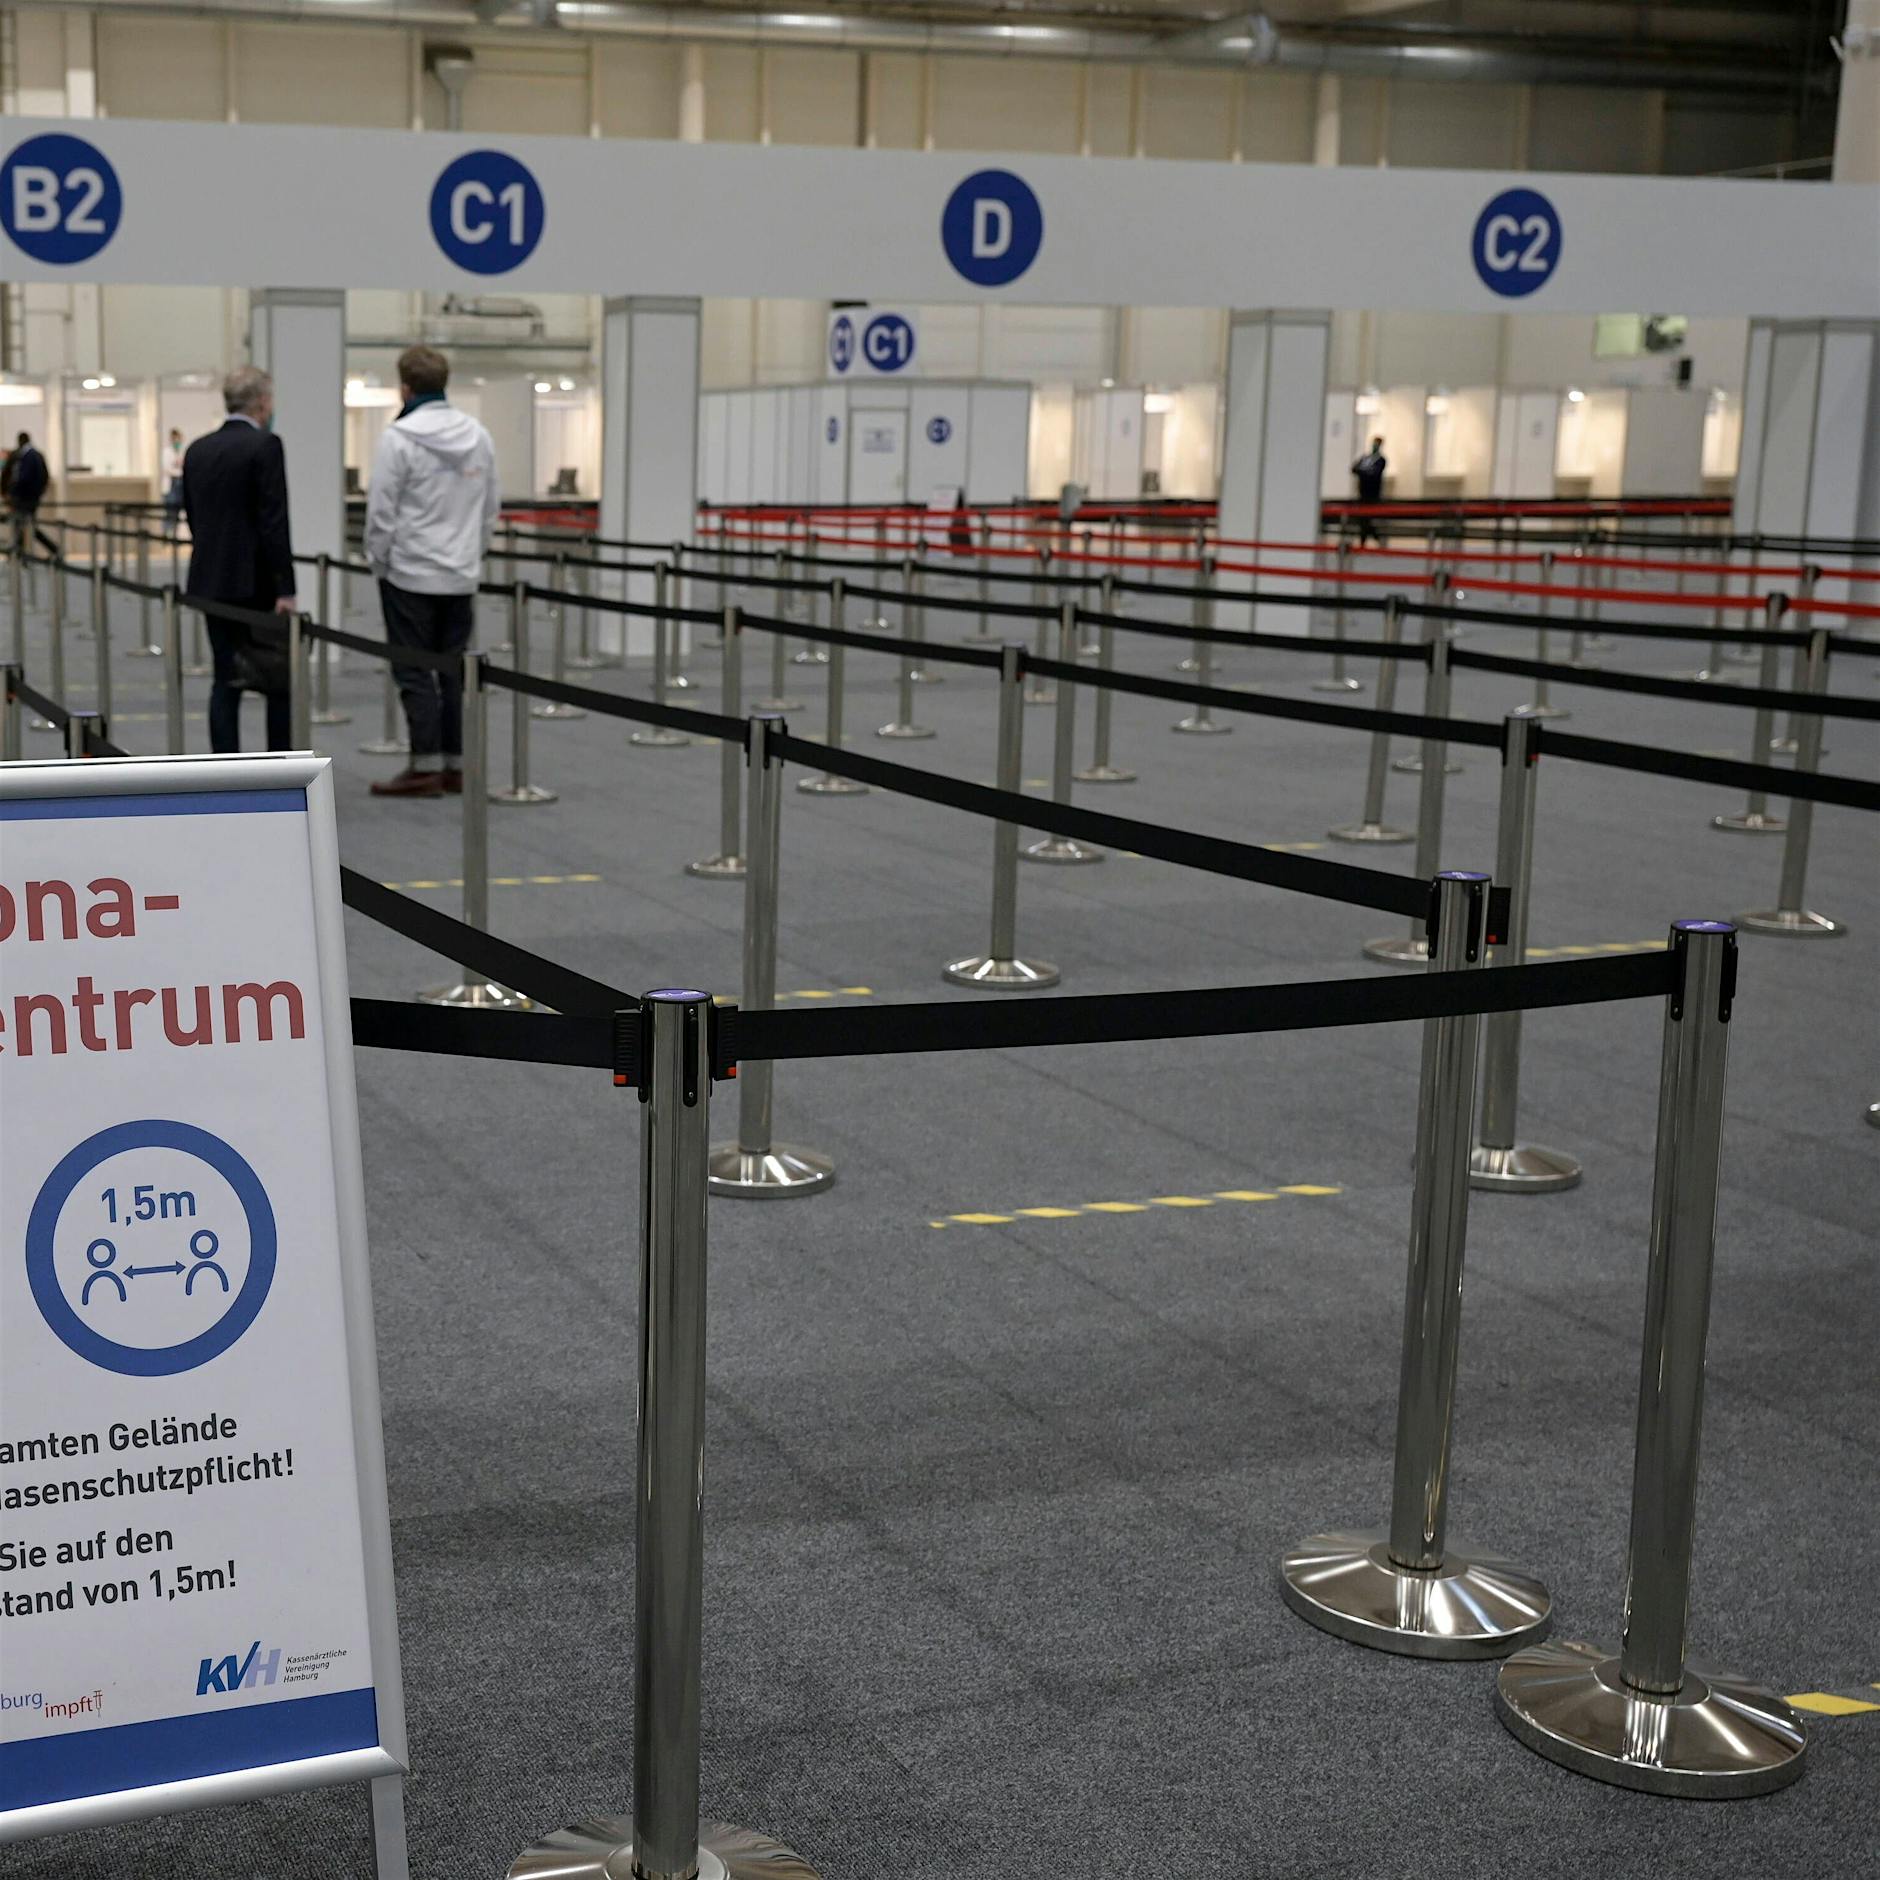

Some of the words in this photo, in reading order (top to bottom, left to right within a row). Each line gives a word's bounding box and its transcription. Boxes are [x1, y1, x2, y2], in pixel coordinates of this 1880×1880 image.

[12, 166, 107, 233] B2
[450, 181, 524, 245] C1
[972, 199, 1012, 258] D
[1483, 214, 1552, 272] C2
[867, 324, 909, 362] C1
[0, 976, 305, 1057] ntrum
[101, 1184, 196, 1227] 1,5m
[0, 1432, 99, 1464] amten
[108, 1412, 237, 1451] Gelände
[0, 1449, 294, 1510] asenschutzpflicht!
[0, 1541, 47, 1572] Sie
[56, 1531, 107, 1564] auf
[116, 1528, 173, 1557] den
[0, 1581, 74, 1617] tand
[83, 1580, 139, 1606] von
[149, 1559, 236, 1601] 1,5m!
[195, 1640, 281, 1696] KVH
[283, 1672, 319, 1684] Hamburg
[285, 1661, 330, 1674] Vereinigung
[286, 1649, 348, 1665] Kassenärztliche
[0, 1692, 43, 1710] burg
[45, 1695, 94, 1719] impft
